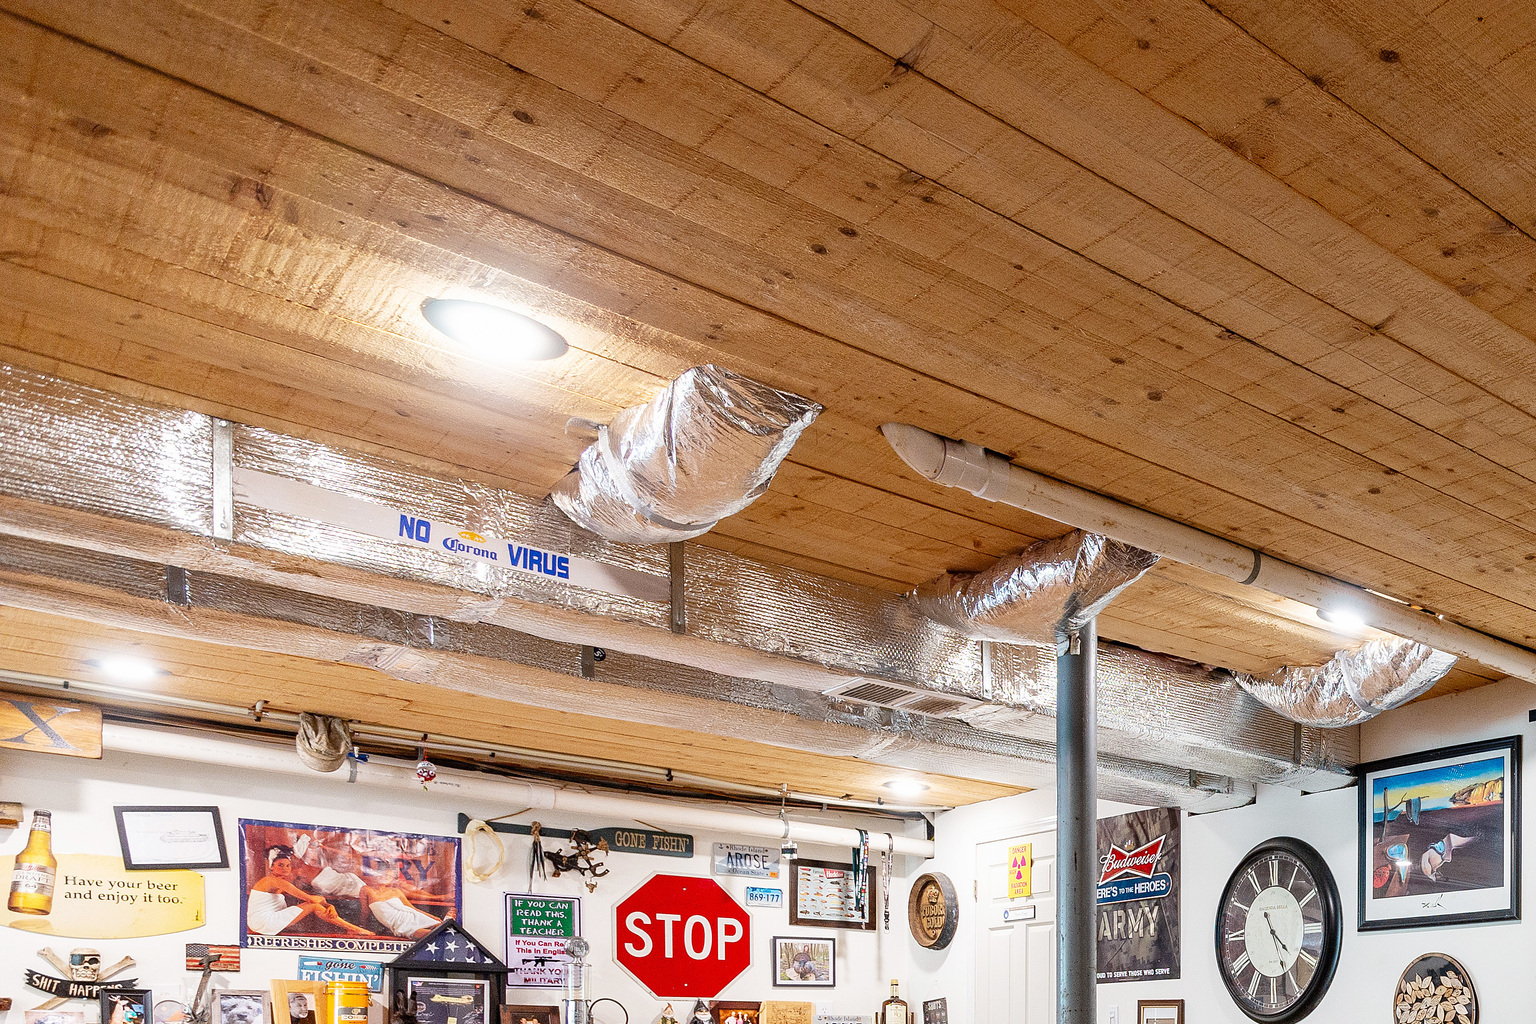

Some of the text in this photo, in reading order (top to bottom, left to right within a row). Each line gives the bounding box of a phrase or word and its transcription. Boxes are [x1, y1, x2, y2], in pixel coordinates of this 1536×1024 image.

[399, 514, 570, 580] NO Corona VIRUS
[614, 831, 690, 853] GONE FISHN'
[729, 844, 747, 852] Rhode
[1011, 846, 1027, 854] DANGER
[362, 856, 436, 881] DRY
[727, 852, 770, 870] AROSE
[1100, 851, 1162, 872] Budweiser
[64, 875, 178, 891] Have your beer
[1096, 886, 1118, 899] ERE'S
[1134, 880, 1166, 894] HEROES
[64, 891, 184, 905] and enjoy it too.
[514, 899, 569, 910] IF YOU CAN
[516, 909, 542, 917] READ
[521, 918, 563, 928] THANK A
[1097, 905, 1160, 941] ARMY
[519, 927, 565, 936] TEACHER
[624, 911, 744, 961] STOP
[255, 936, 412, 952] REFRESHES COMPLETE
[542, 948, 566, 956] Englis
[324, 961, 356, 971] gone
[514, 967, 546, 975] THANK
[1113, 970, 1127, 978] SERVE
[1128, 969, 1143, 977] THOSE
[32, 974, 123, 997] SHIT HAPP
